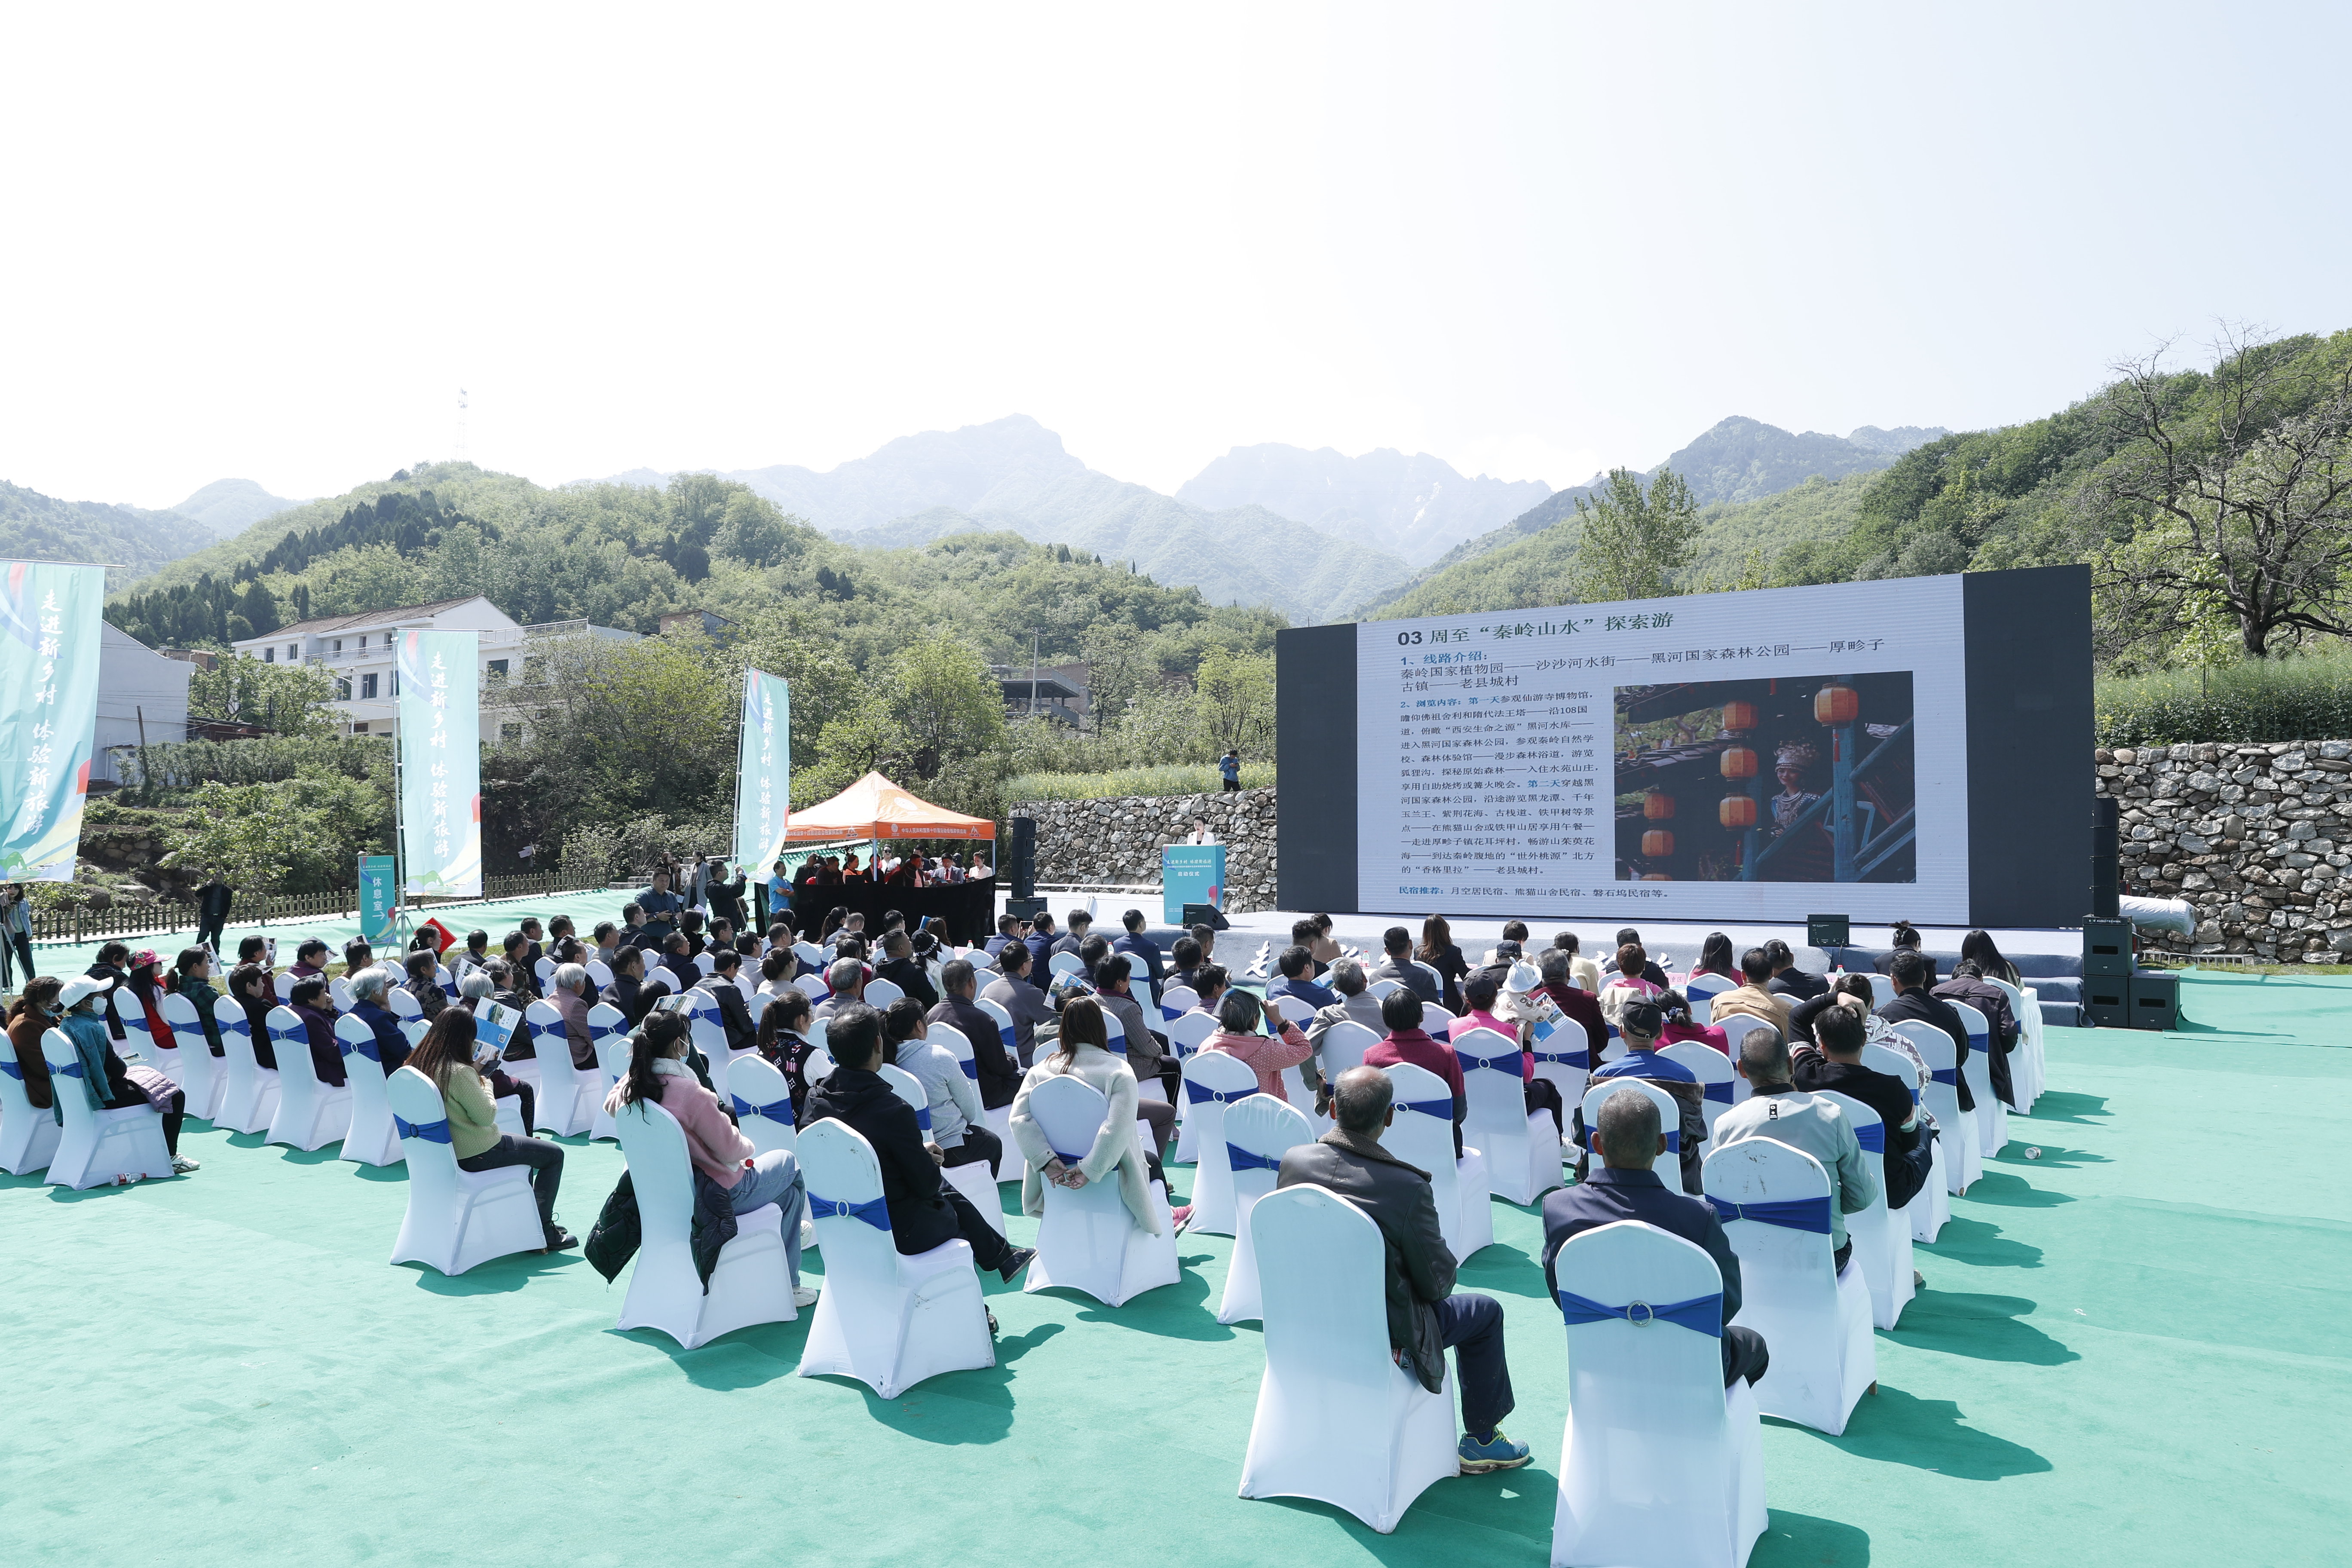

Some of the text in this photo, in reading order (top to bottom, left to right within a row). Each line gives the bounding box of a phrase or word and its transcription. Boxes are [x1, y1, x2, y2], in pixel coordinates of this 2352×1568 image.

[1397, 631, 1423, 645] 03
[23, 588, 64, 835] 走进新乡村 体验新旅游
[429, 651, 451, 858] 走进新乡村 体验新旅游
[758, 692, 774, 853] 走进新乡村 体验新旅游
[373, 877, 383, 911] 休息室
[1245, 940, 1270, 978] 走
